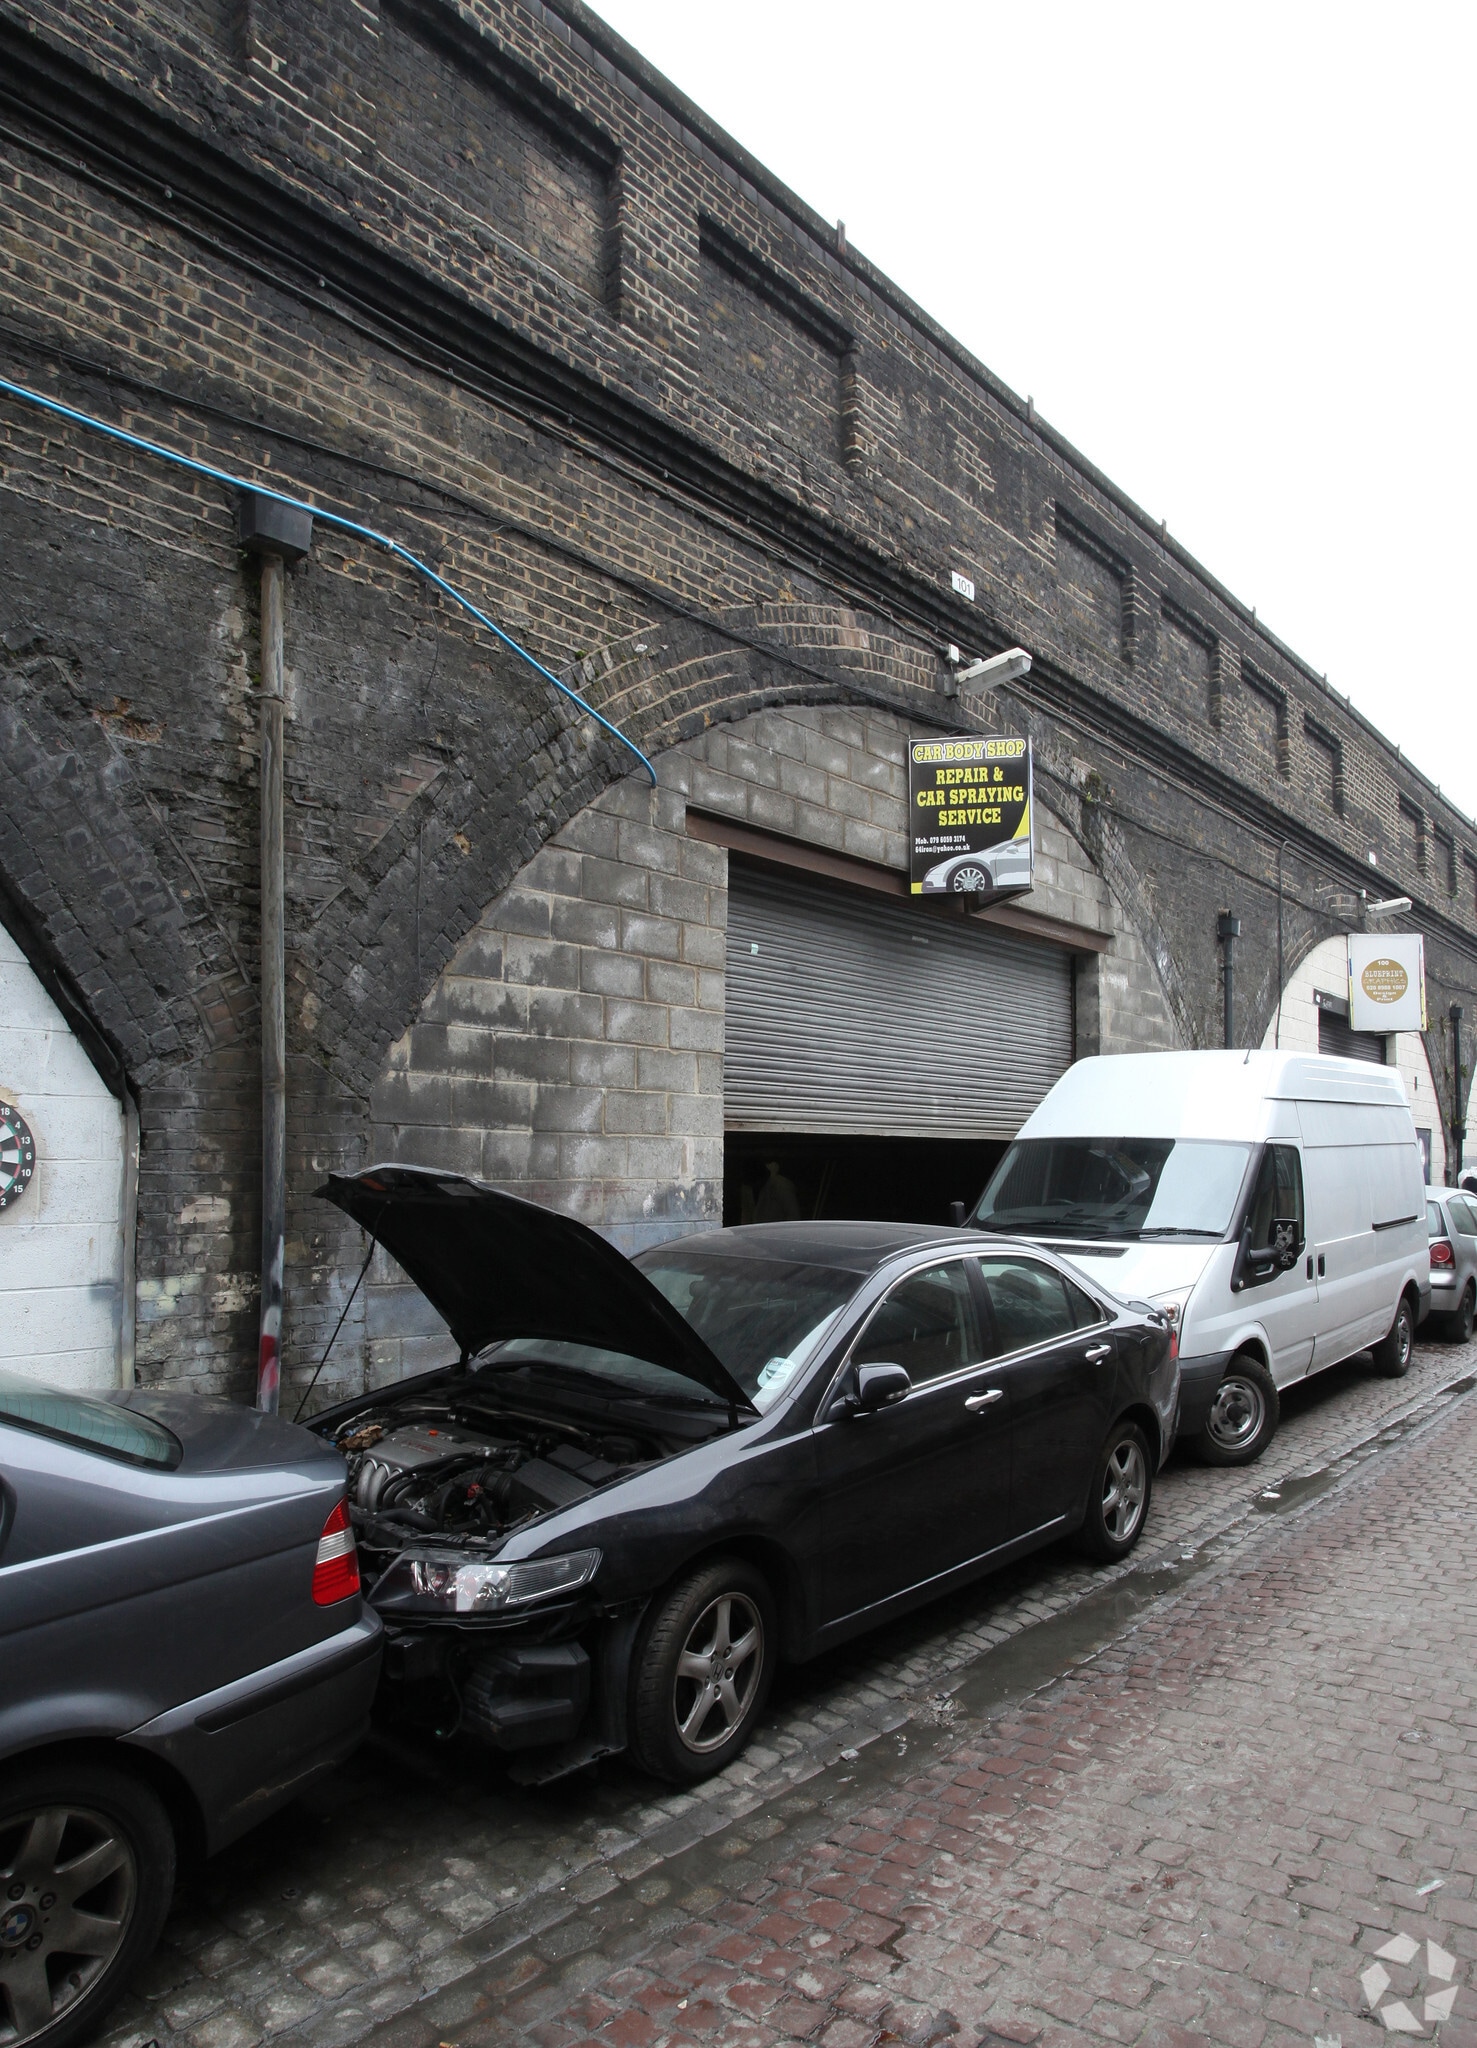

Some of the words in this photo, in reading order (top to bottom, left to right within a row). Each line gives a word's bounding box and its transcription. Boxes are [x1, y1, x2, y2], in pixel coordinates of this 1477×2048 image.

[957, 578, 970, 595] 101
[914, 745, 942, 762] CAR
[945, 741, 984, 760] BODY
[986, 739, 1025, 758] SHOP
[936, 766, 988, 784] REPAIR
[993, 766, 1003, 782] &
[916, 790, 945, 806] CAR
[949, 786, 1024, 805] SPRAYING
[938, 808, 1001, 826] SERVICE
[0, 1108, 10, 1116] 18
[15, 1121, 21, 1129] 4
[21, 1136, 31, 1144] 13
[25, 1152, 32, 1160] 6
[21, 1168, 32, 1177] 10
[13, 1184, 23, 1193] 15
[0, 1197, 6, 1206] 2
